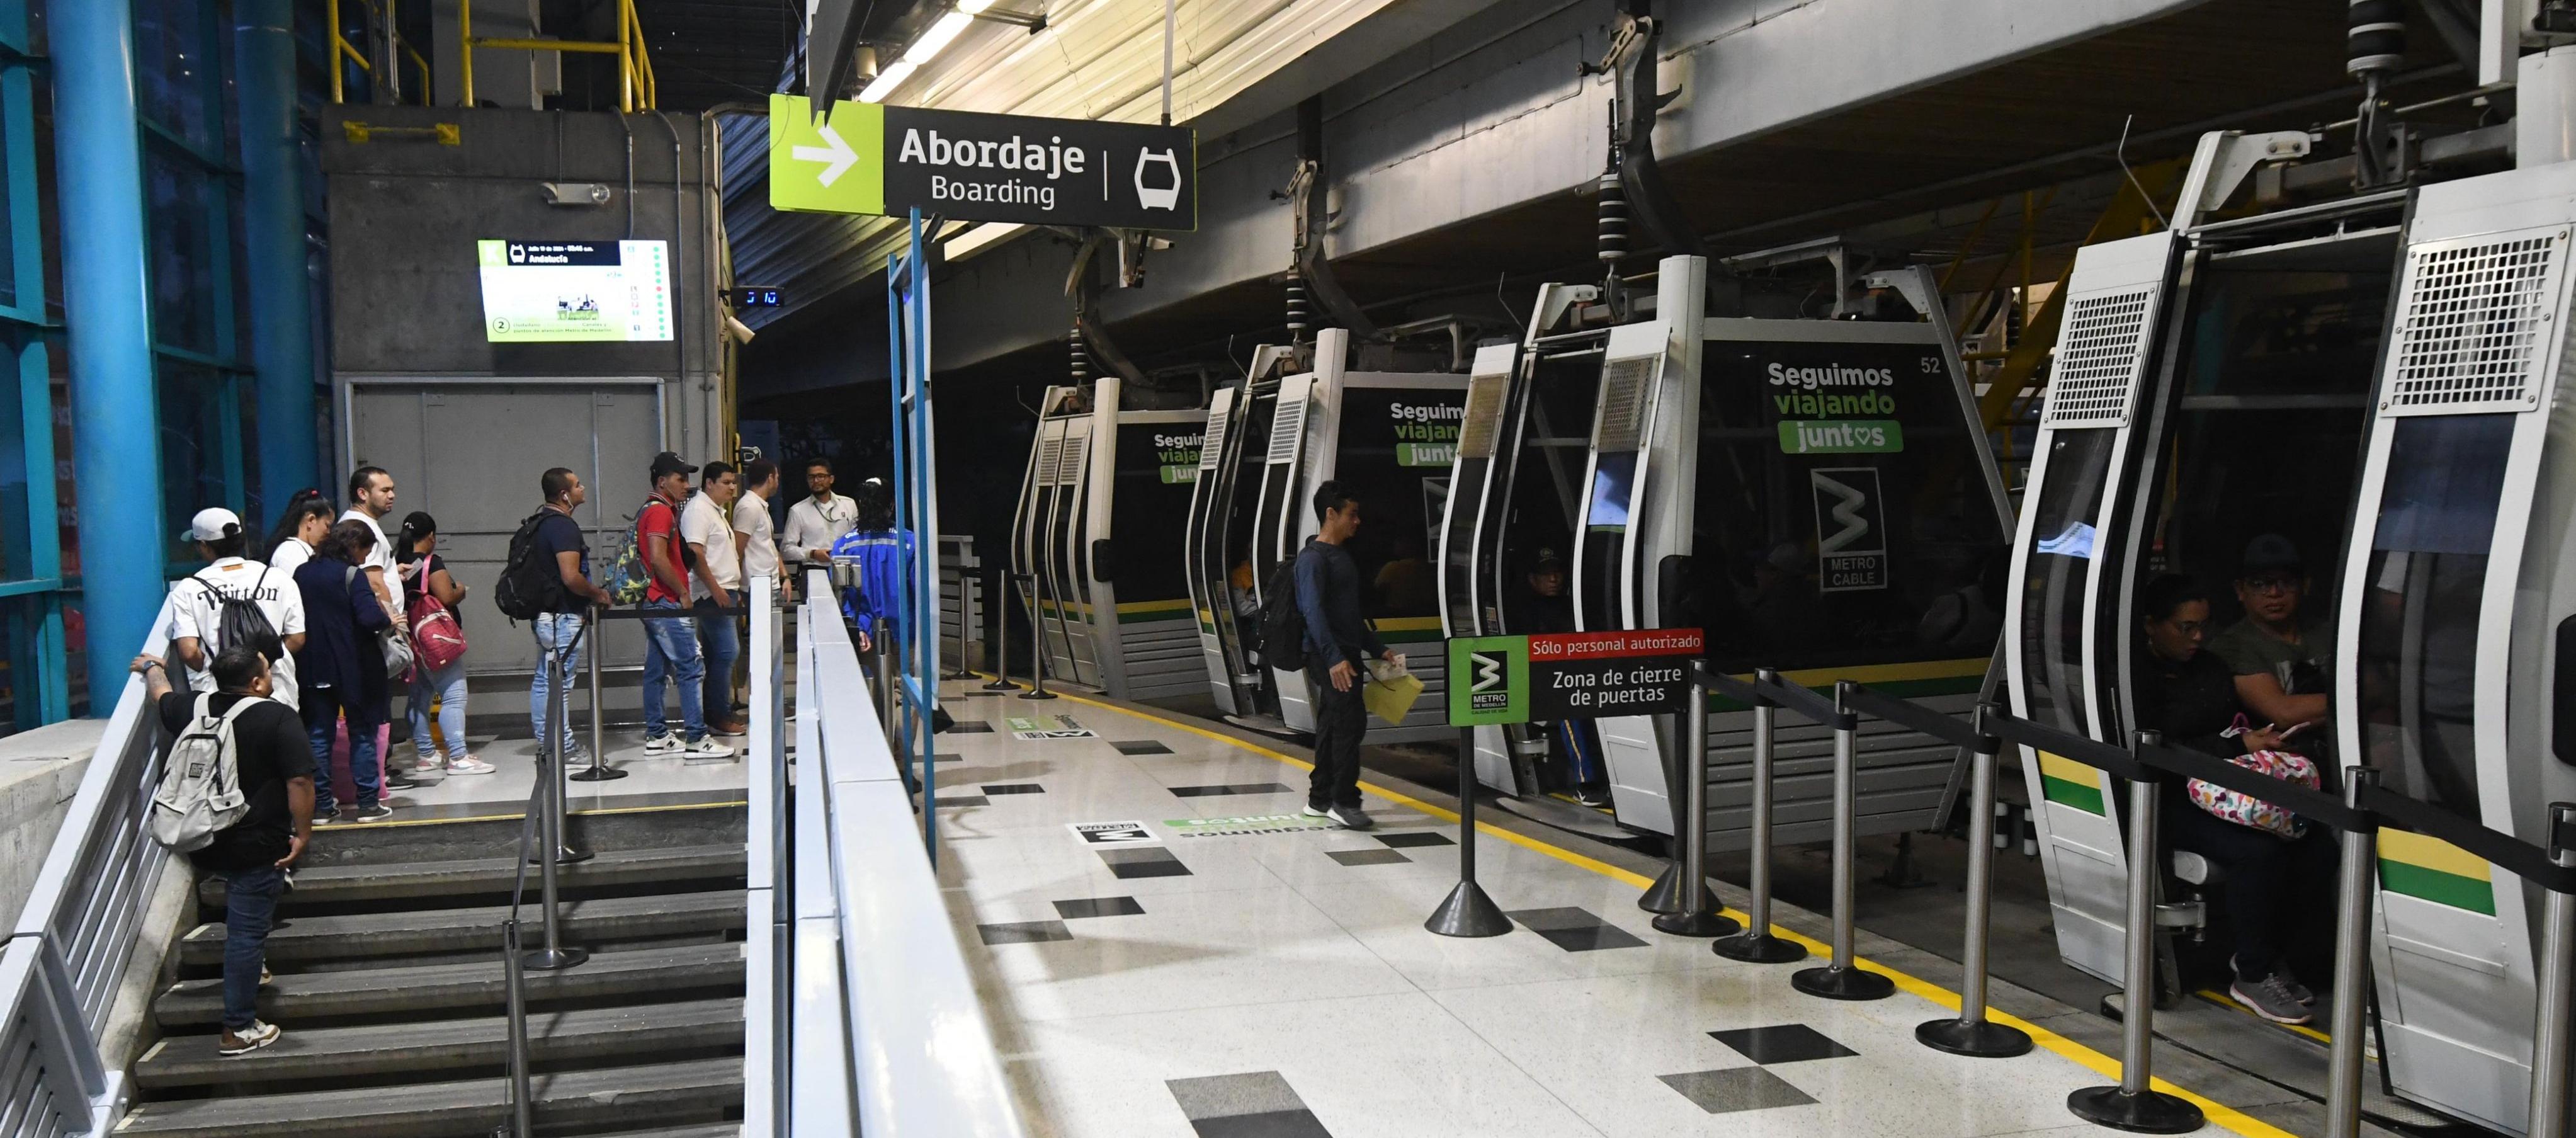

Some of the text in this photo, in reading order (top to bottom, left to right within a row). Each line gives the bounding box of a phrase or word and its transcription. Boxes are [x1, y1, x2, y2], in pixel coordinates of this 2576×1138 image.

[899, 128, 1085, 179] Abordaje
[931, 175, 1055, 210] Boarding
[529, 254, 568, 263] Andalucía
[1921, 357, 1941, 373] 52
[1768, 363, 1893, 390] Seguimos
[1390, 402, 1464, 423] Seguim
[1773, 389, 1895, 419] viajando
[1154, 433, 1205, 448] Segui
[1394, 421, 1460, 442] viajan
[1157, 448, 1201, 464] viaja
[1411, 443, 1455, 465] junt
[1171, 465, 1198, 483] jun
[1832, 557, 1875, 571] METRO
[1833, 572, 1875, 586] CABLE
[1533, 635, 1700, 656] Sólo personal autorizado
[1553, 666, 1682, 688] Zona de cierre
[1473, 695, 1506, 703] METRO
[1570, 687, 1665, 708] de puertas
